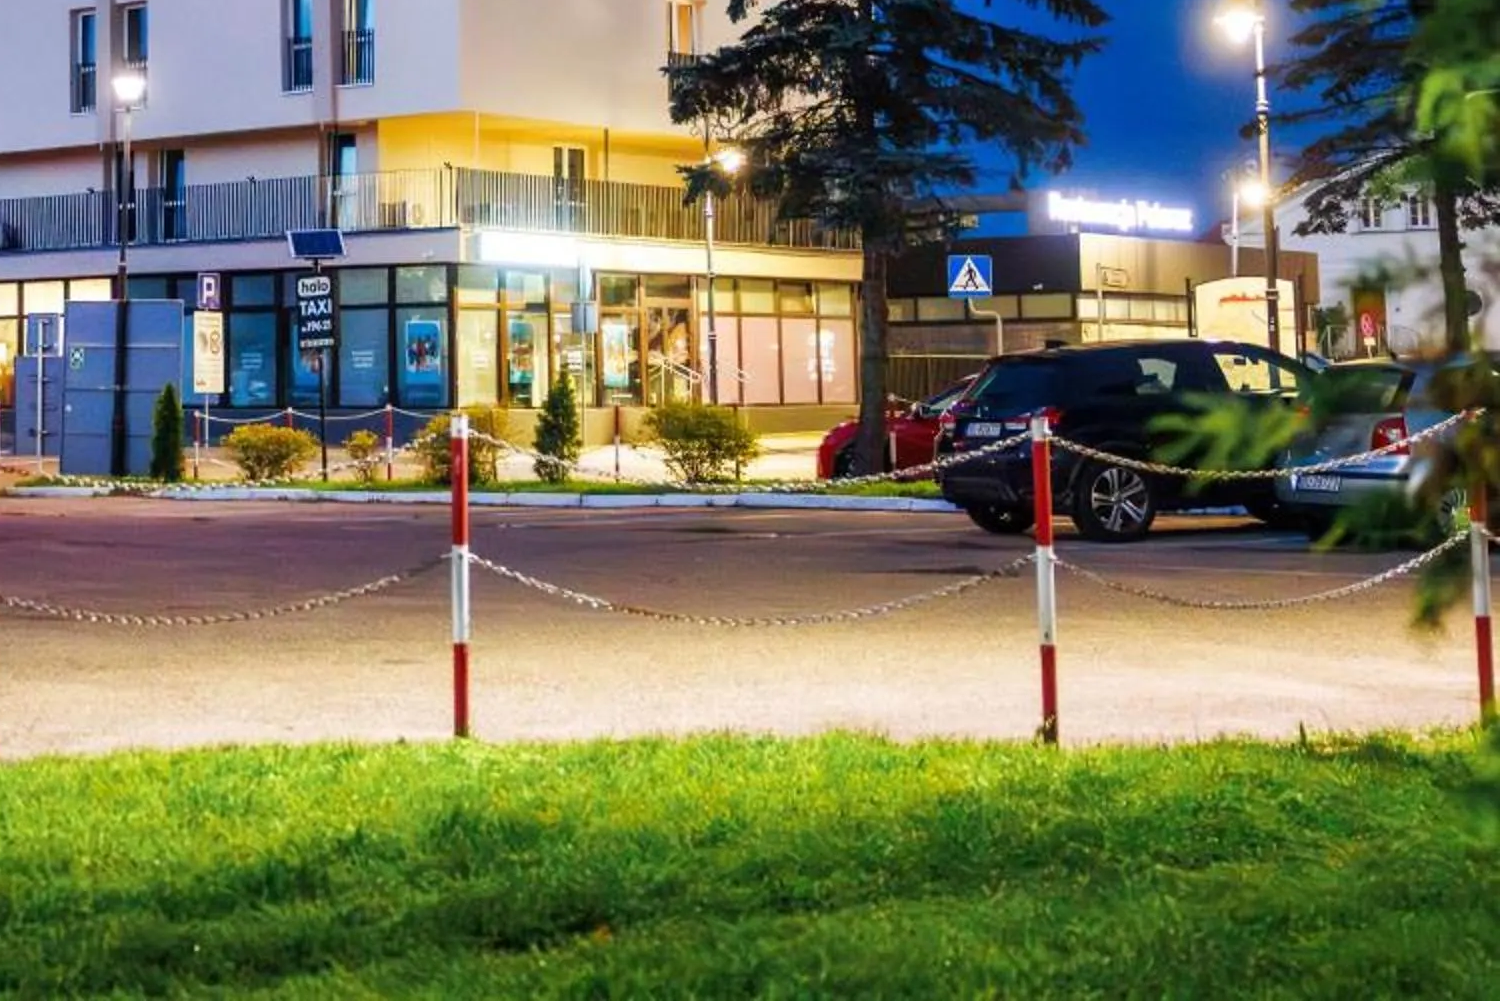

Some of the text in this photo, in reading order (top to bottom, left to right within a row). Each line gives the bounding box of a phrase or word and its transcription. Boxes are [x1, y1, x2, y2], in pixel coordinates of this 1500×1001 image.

[203, 277, 215, 304] P
[301, 280, 329, 294] halo
[299, 298, 332, 316] TAXI
